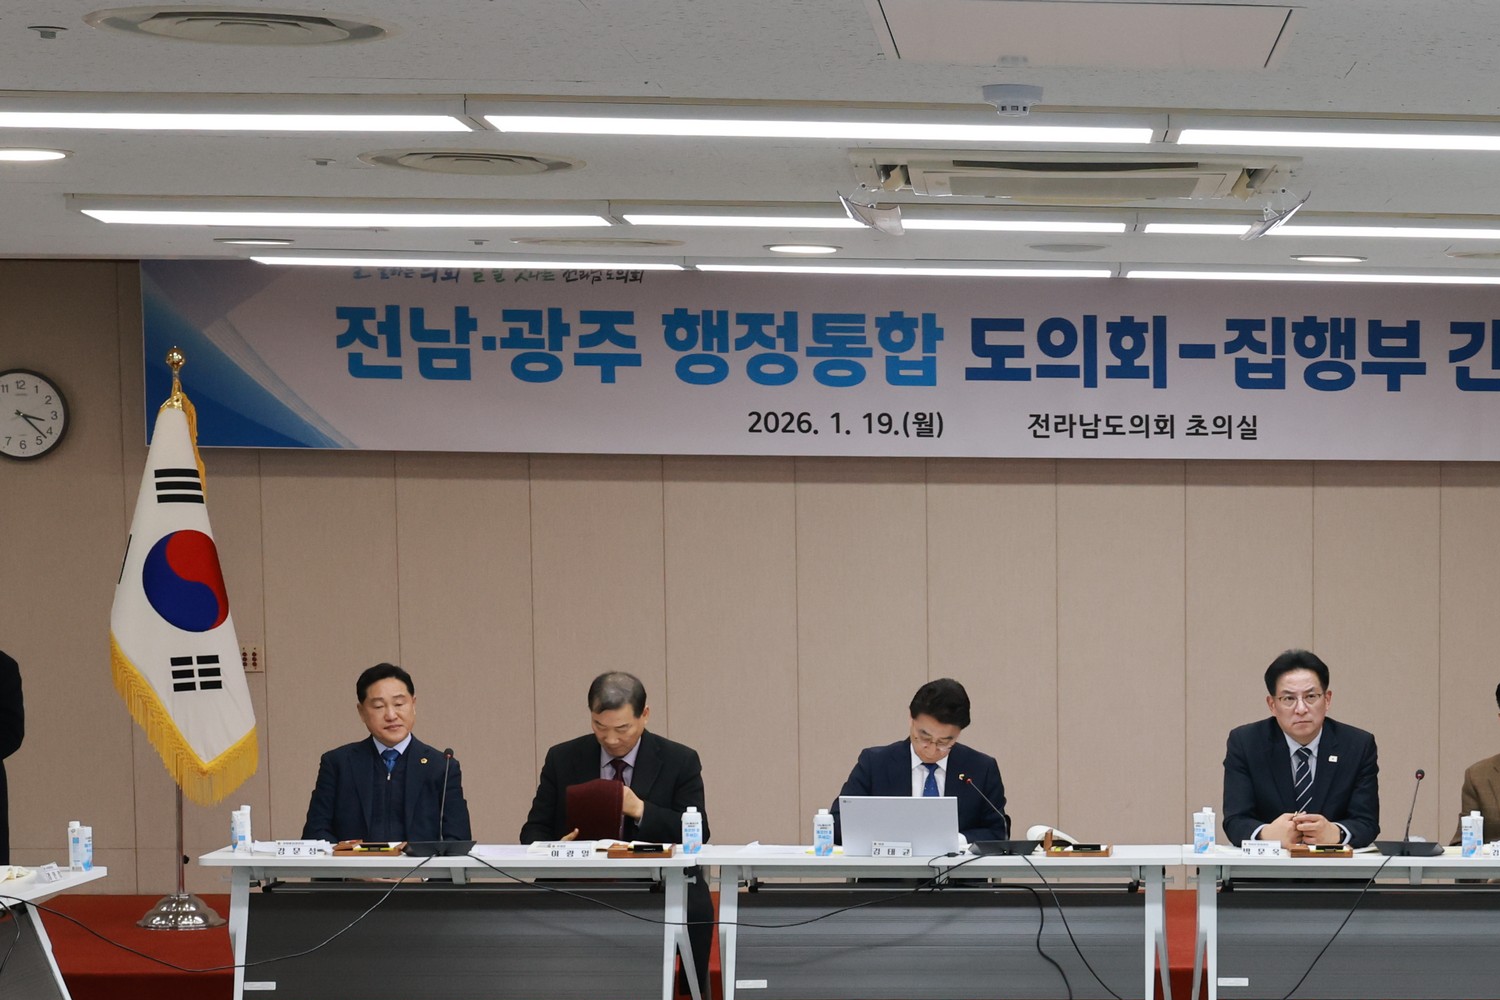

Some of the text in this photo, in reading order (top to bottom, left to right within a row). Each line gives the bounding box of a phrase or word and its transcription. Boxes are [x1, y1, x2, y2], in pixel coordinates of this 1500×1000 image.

[662, 308, 944, 387] 행정통합
[965, 314, 1426, 392] 도의회-집행부
[1, 384, 9, 393] 11
[16, 380, 26, 390] 12
[34, 385, 39, 394] 1
[45, 395, 52, 405] 2
[51, 411, 58, 420] 3
[748, 411, 944, 438] 2026. 1. 19.(월)
[1027, 413, 1258, 440] 전라남도의회 초의실
[46, 427, 53, 435] 4
[5, 436, 12, 446] 7
[20, 440, 27, 449] 6
[36, 436, 43, 445] 5
